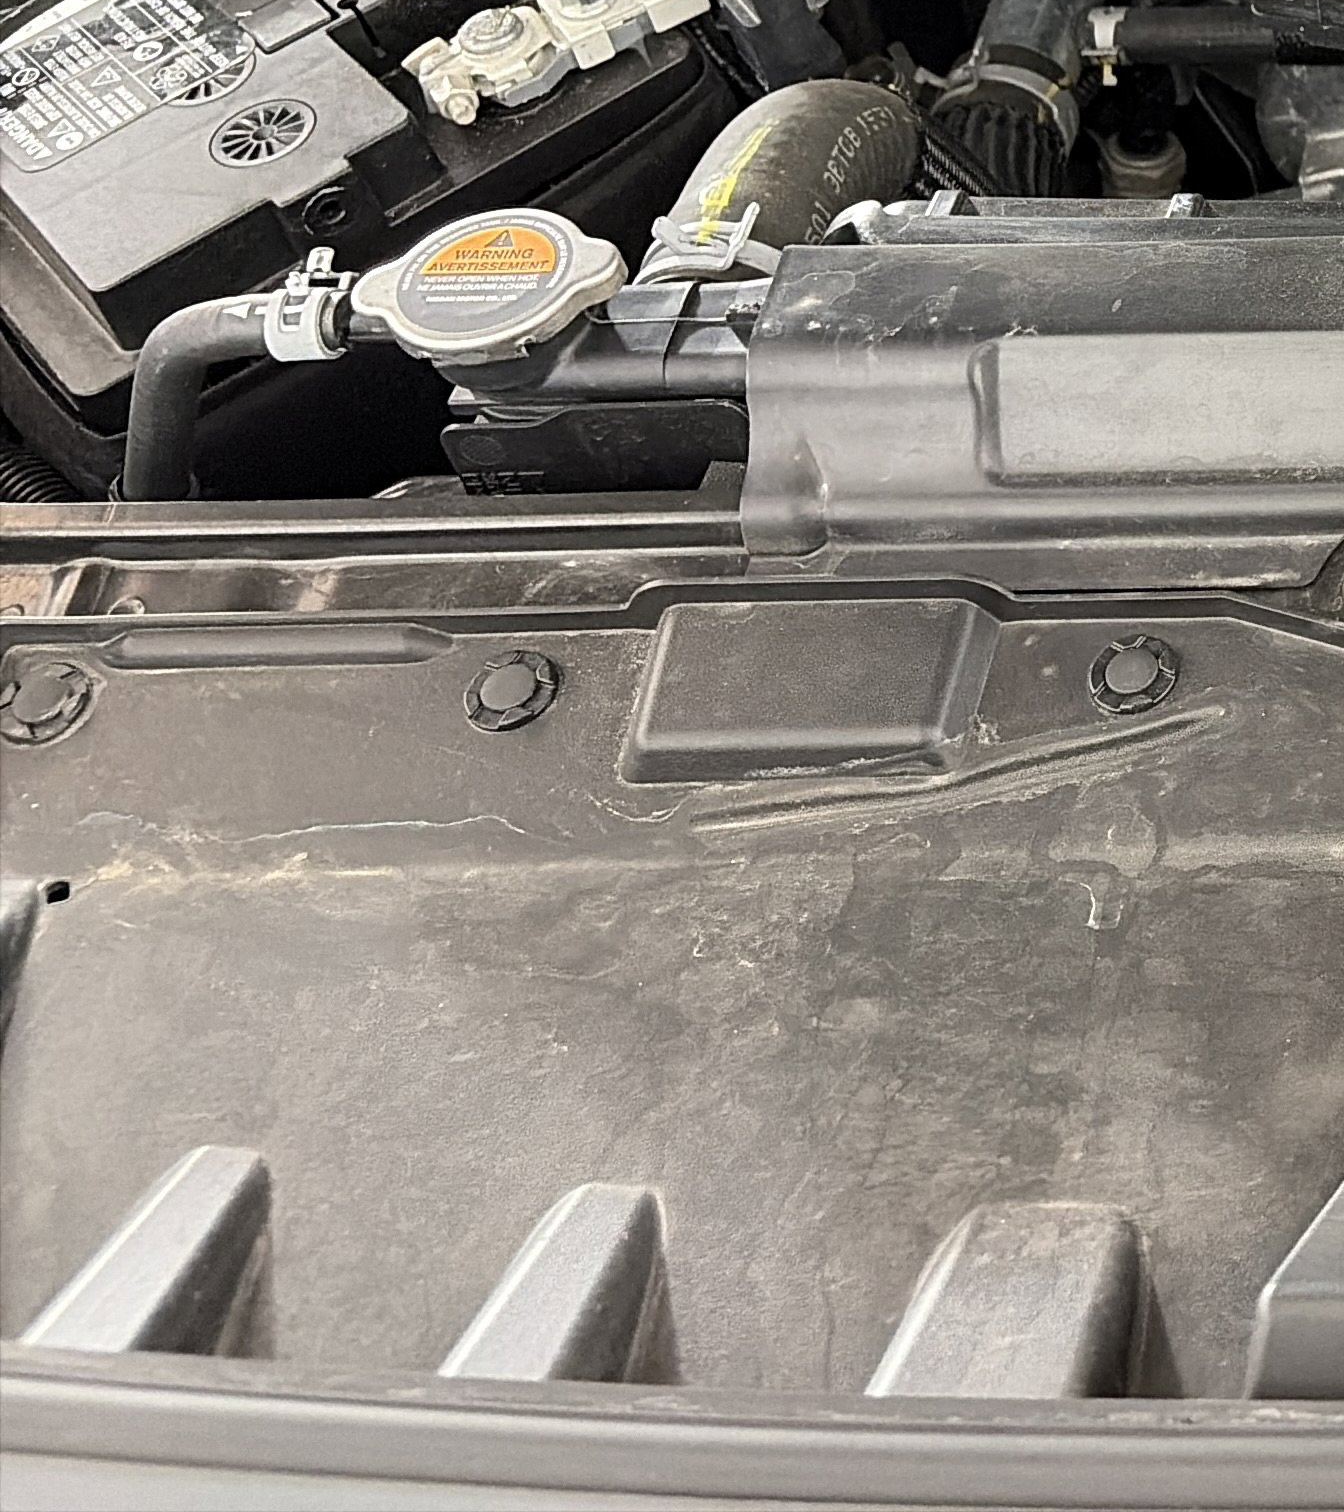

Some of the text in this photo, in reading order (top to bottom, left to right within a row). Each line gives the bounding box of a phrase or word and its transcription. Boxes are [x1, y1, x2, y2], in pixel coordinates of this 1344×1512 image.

[454, 248, 534, 260] WARNING
[427, 260, 550, 272] AVERTISSEMENT
[423, 275, 456, 283] NEVER
[486, 274, 517, 282] WHEN
